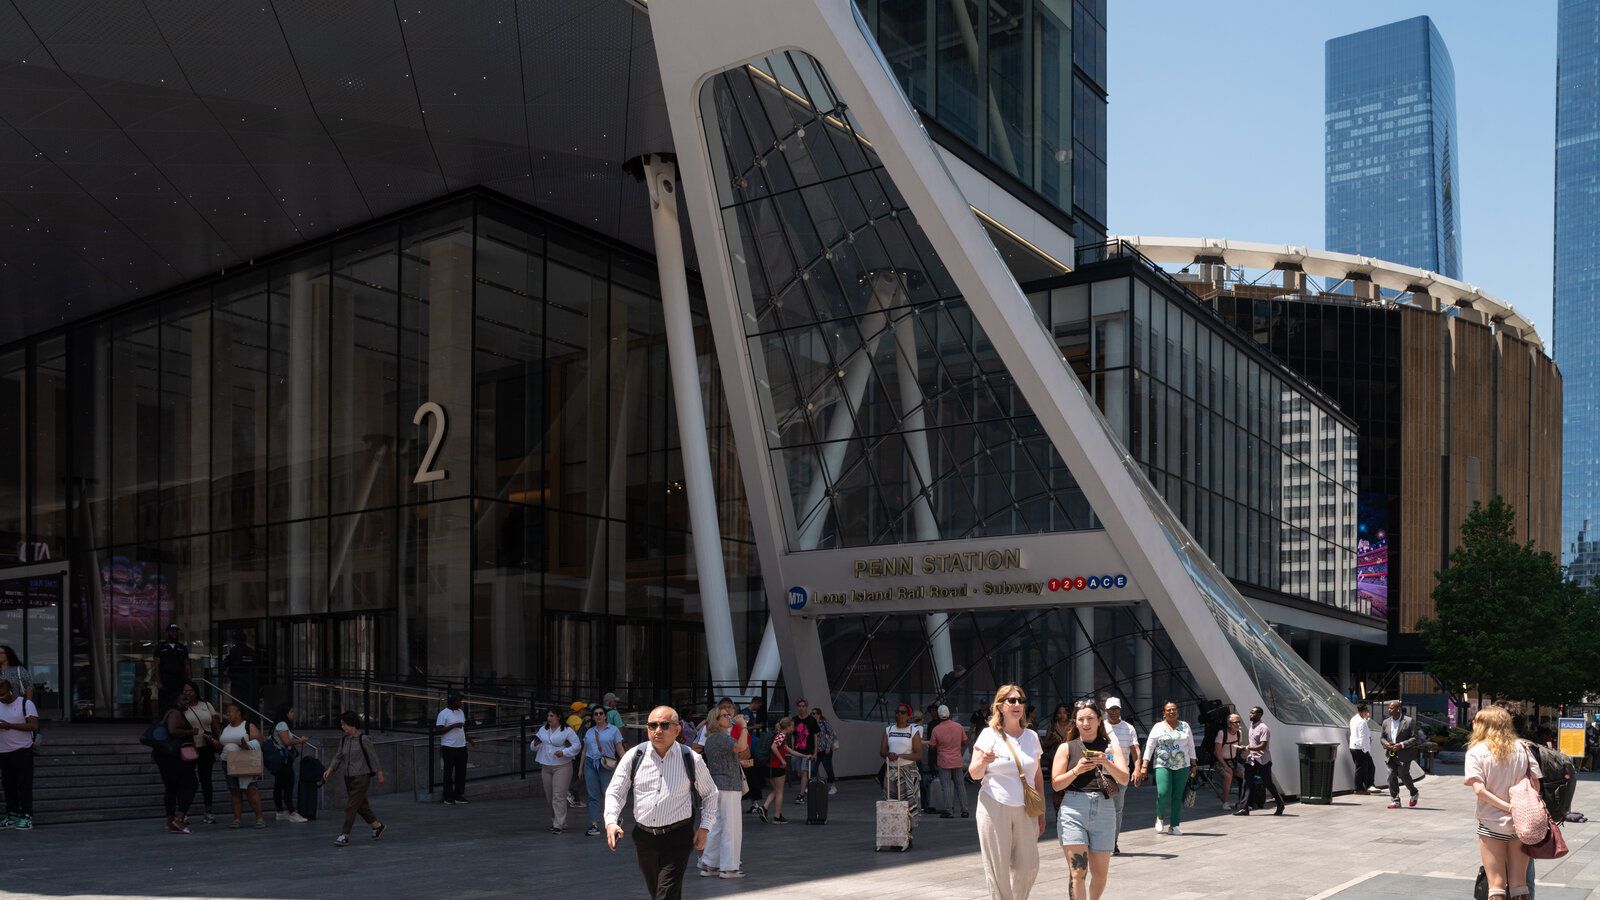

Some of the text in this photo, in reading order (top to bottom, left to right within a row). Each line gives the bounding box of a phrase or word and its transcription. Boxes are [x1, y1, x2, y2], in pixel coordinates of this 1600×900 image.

[413, 401, 446, 484] 2
[854, 548, 1021, 578] PENN STATION
[813, 591, 847, 606] Long
[851, 588, 893, 602] Island
[898, 585, 925, 600] Rail
[930, 583, 968, 598] Road
[984, 582, 1044, 595] Subway
